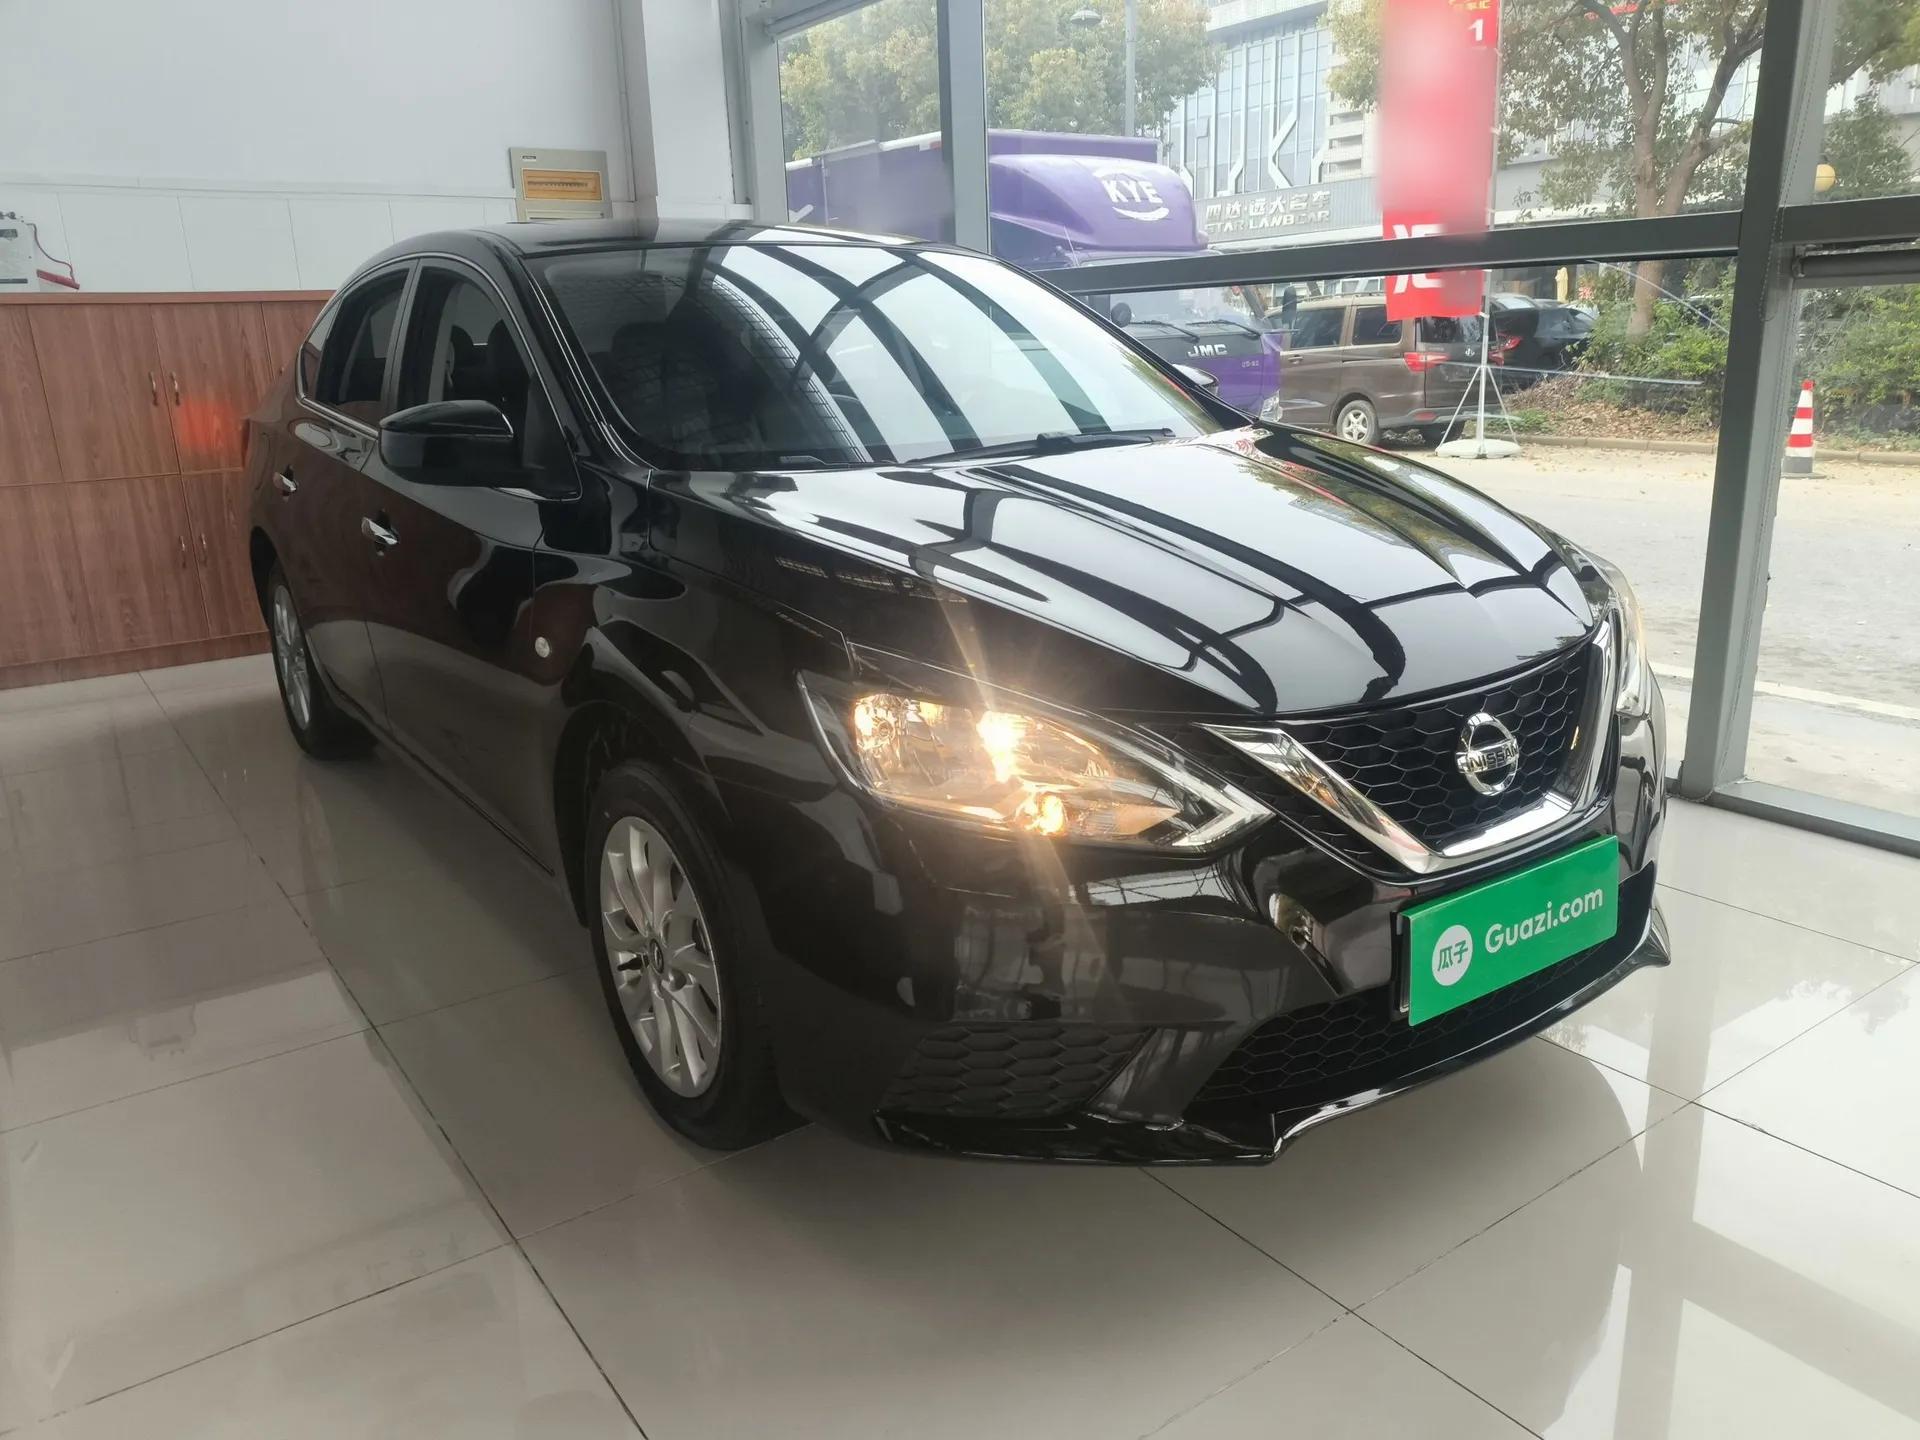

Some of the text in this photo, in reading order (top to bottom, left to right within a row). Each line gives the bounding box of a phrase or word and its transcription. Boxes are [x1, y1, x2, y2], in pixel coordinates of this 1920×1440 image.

[1102, 179, 1163, 203] KYE
[1187, 343, 1228, 358] JMC
[1467, 744, 1520, 770] NISSAN
[1485, 888, 1604, 954] Guazi.com
[1437, 939, 1469, 972] 瓜子
